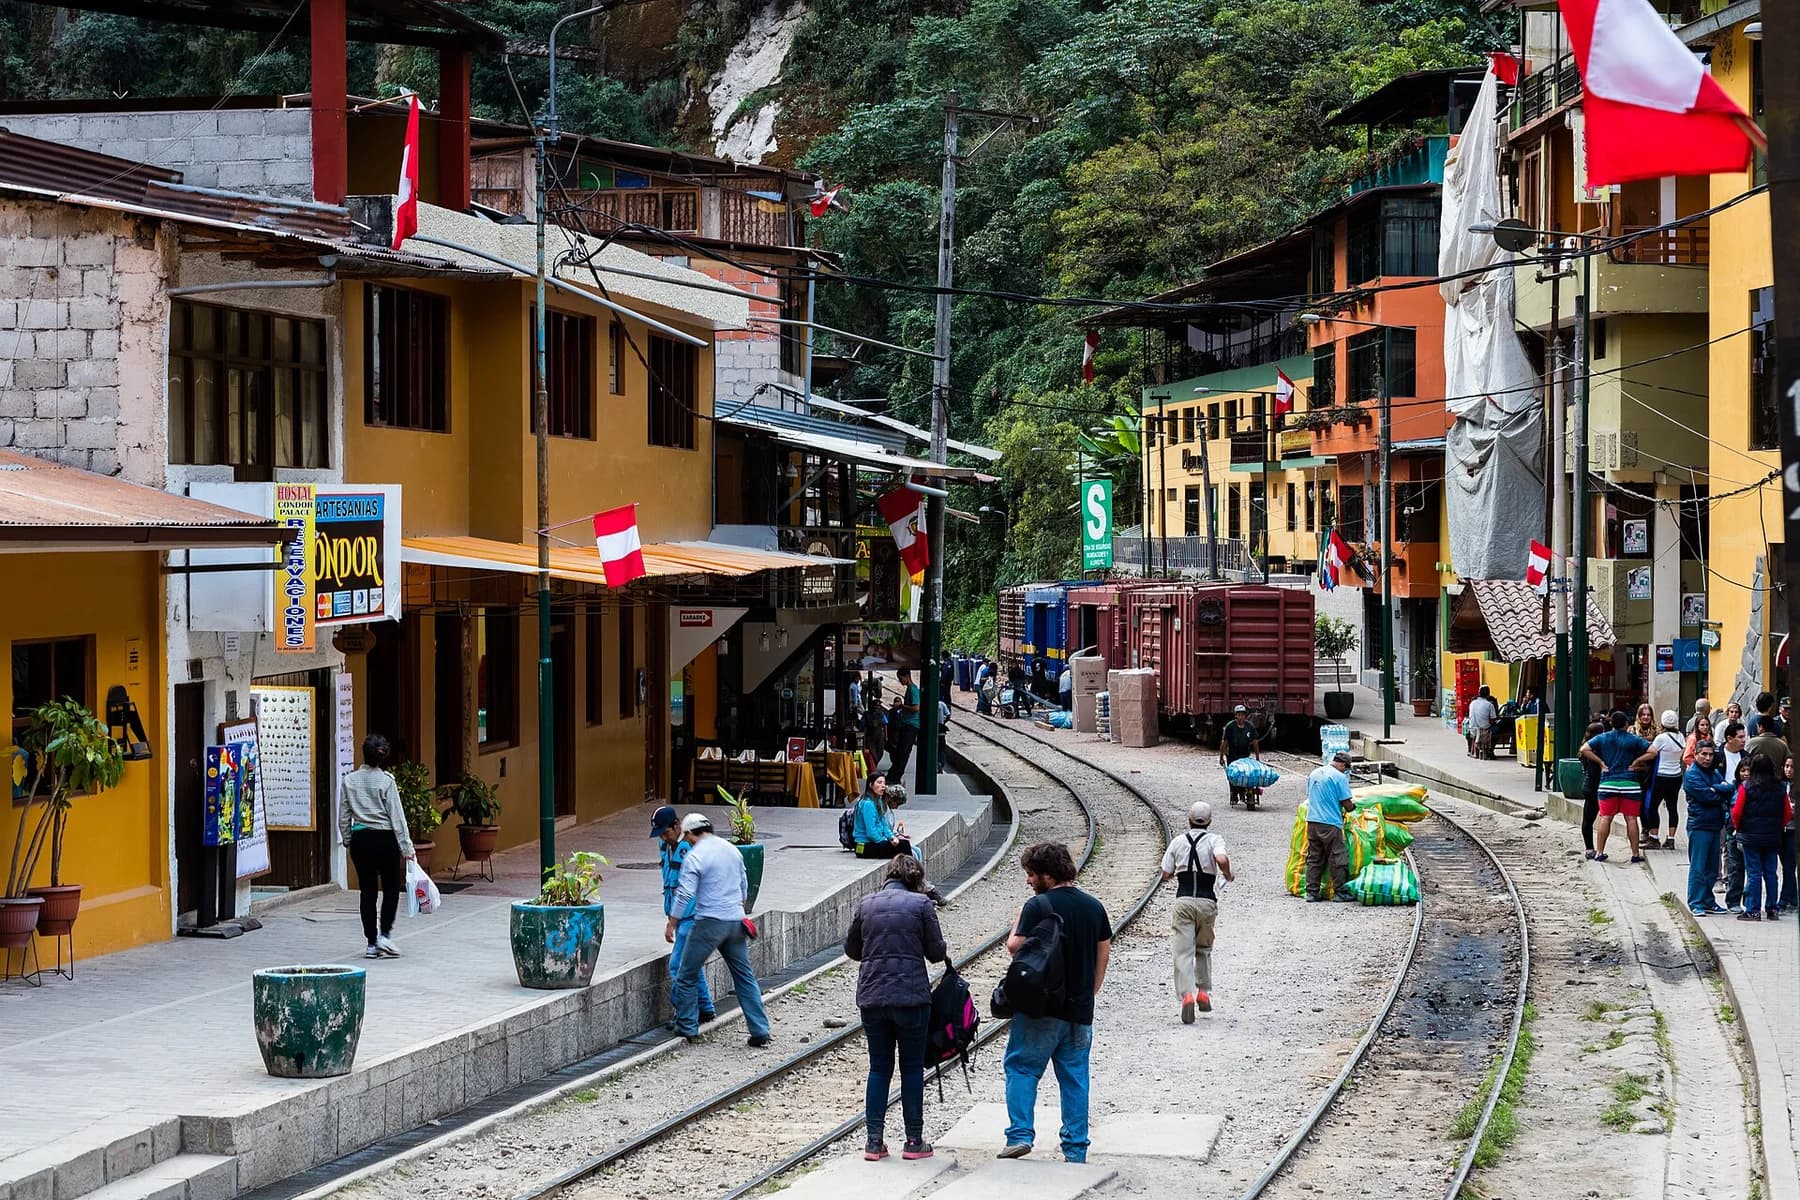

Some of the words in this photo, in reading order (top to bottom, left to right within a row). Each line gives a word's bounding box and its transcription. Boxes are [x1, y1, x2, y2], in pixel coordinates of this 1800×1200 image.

[277, 486, 312, 500] HOSTAL
[277, 501, 313, 509] CONDOR
[315, 500, 378, 517] ARTESANIAS
[1087, 484, 1107, 540] S
